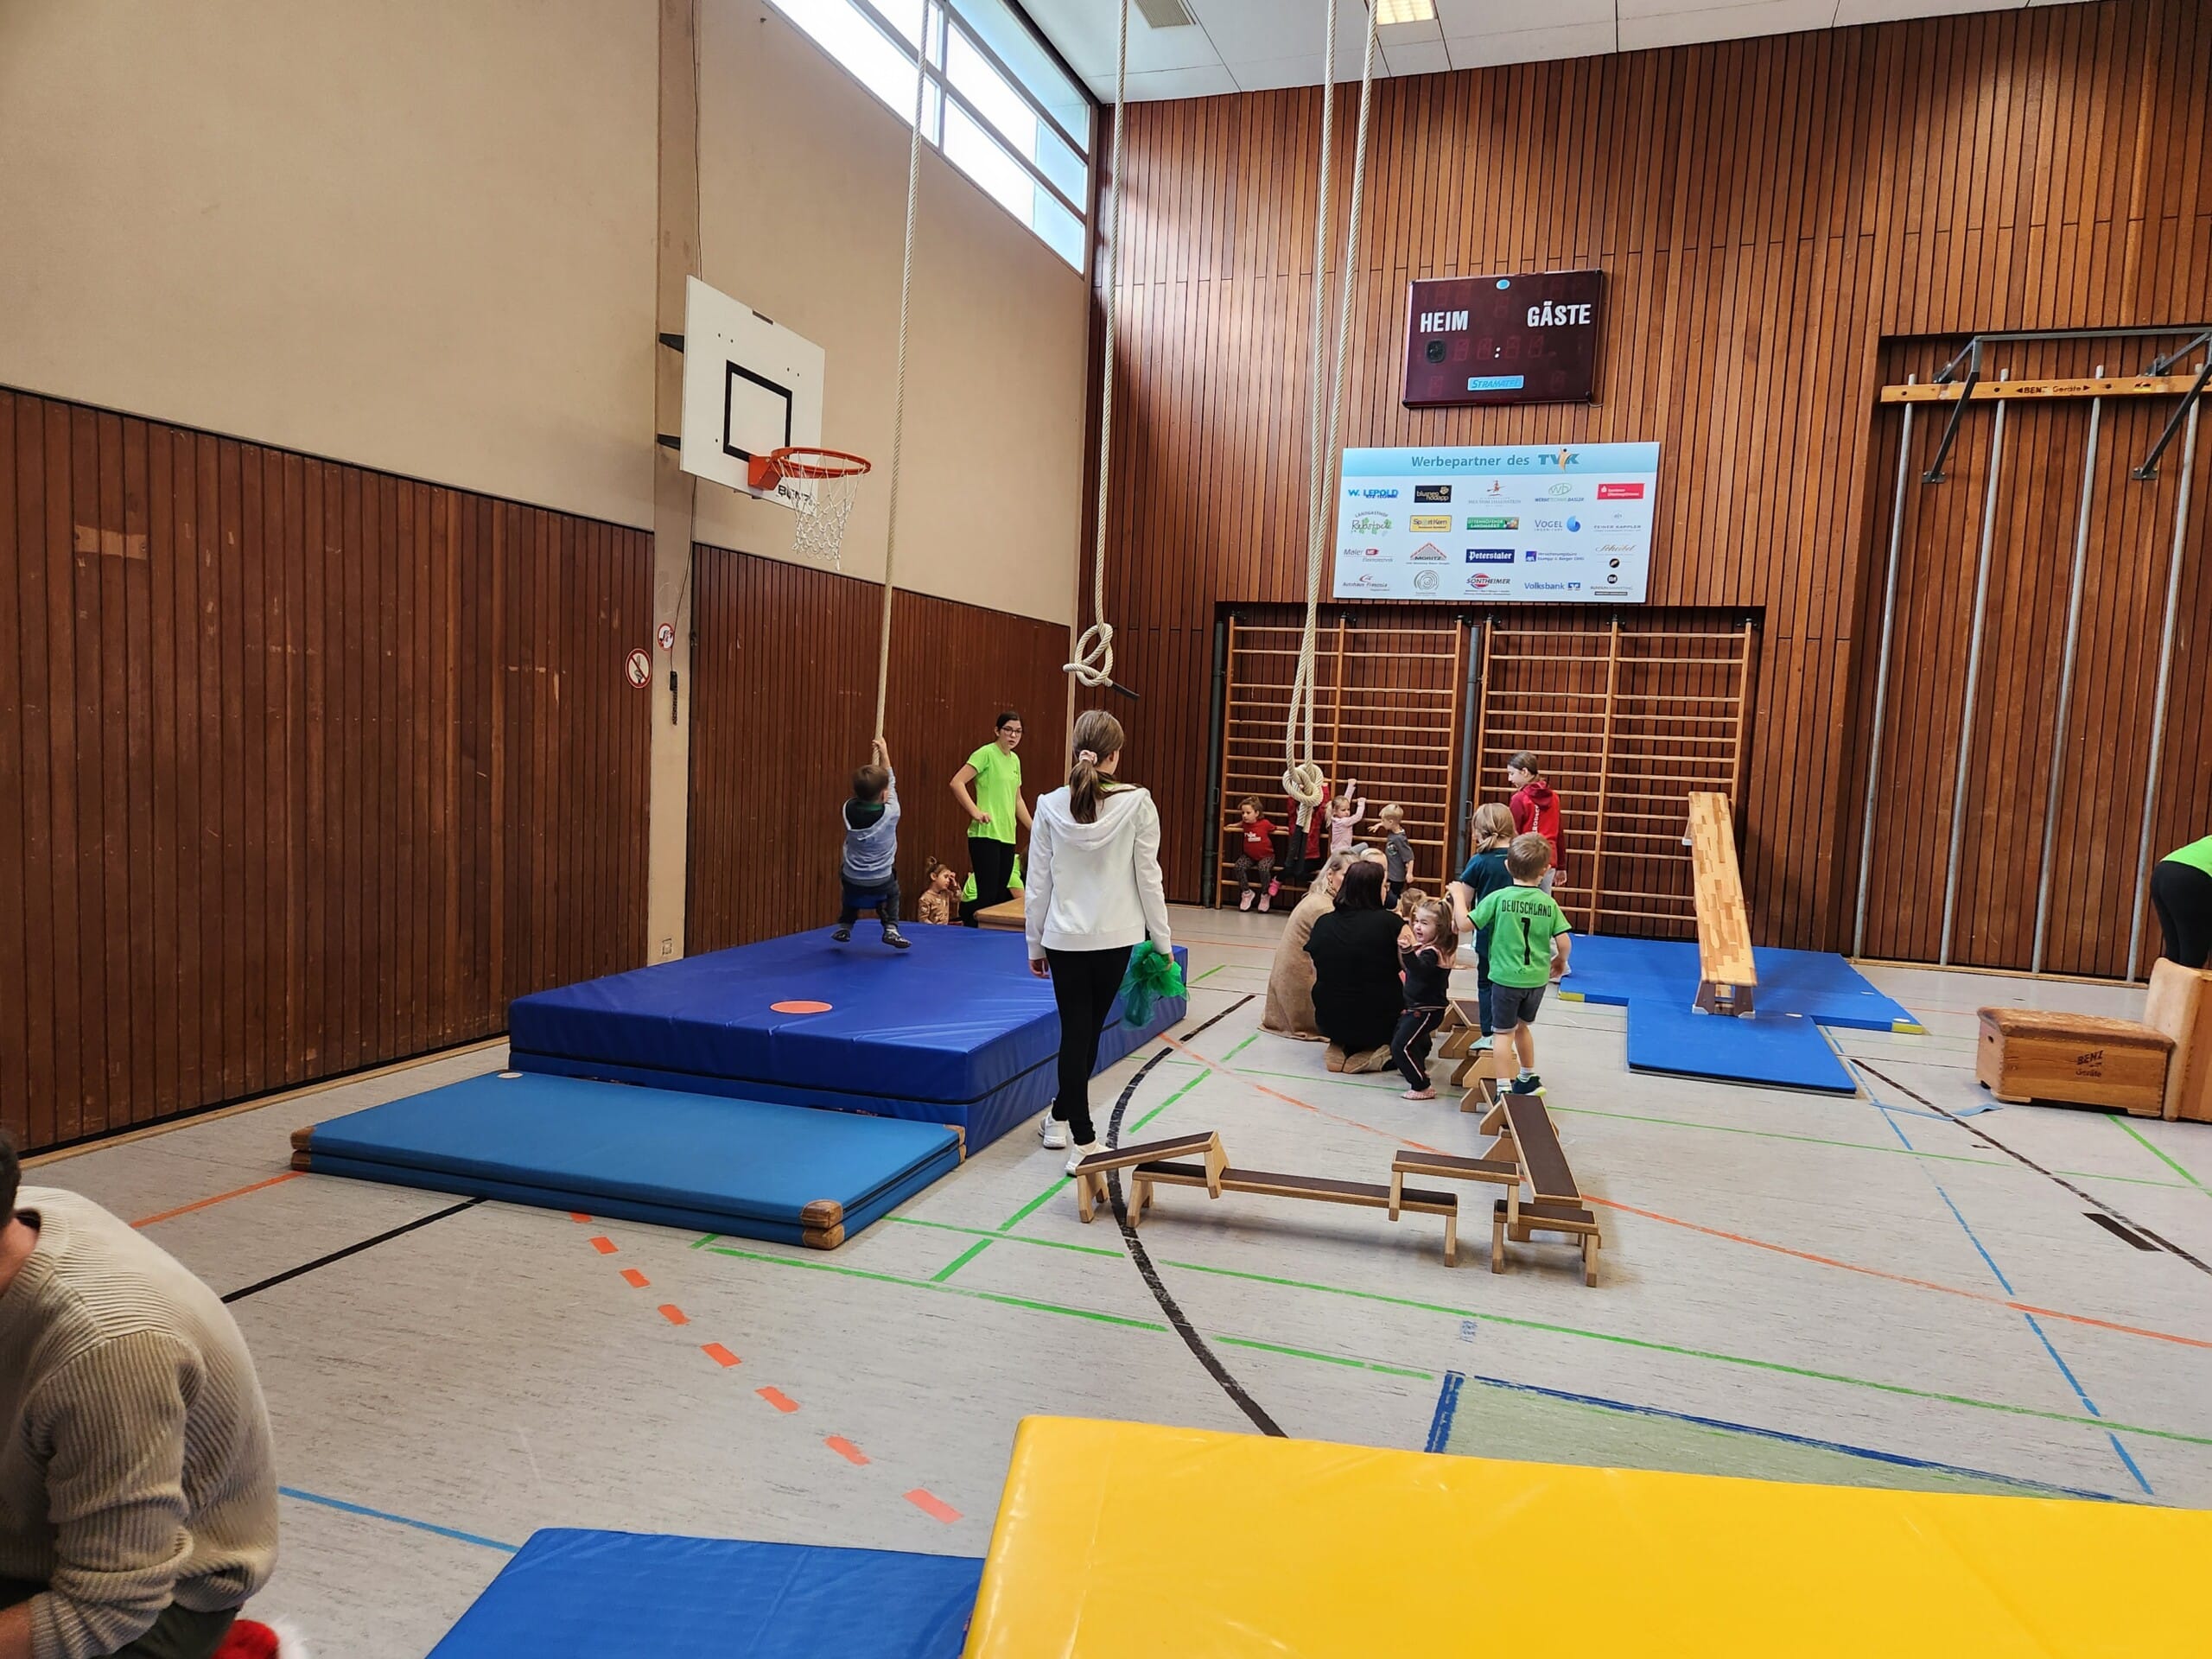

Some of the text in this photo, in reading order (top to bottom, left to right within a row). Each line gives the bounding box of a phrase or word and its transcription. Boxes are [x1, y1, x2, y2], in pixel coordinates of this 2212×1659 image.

[1420, 301, 1592, 333] HEIM GÄSTE
[1411, 454, 1580, 468] Werbepartner des TVK
[1535, 519, 1562, 528] VOGEL
[1469, 551, 1512, 561] Peterstaler
[1502, 899, 1552, 917] DEUTSCHLAND
[1521, 917, 1530, 965] 1
[2077, 1050, 2103, 1065] BENZ
